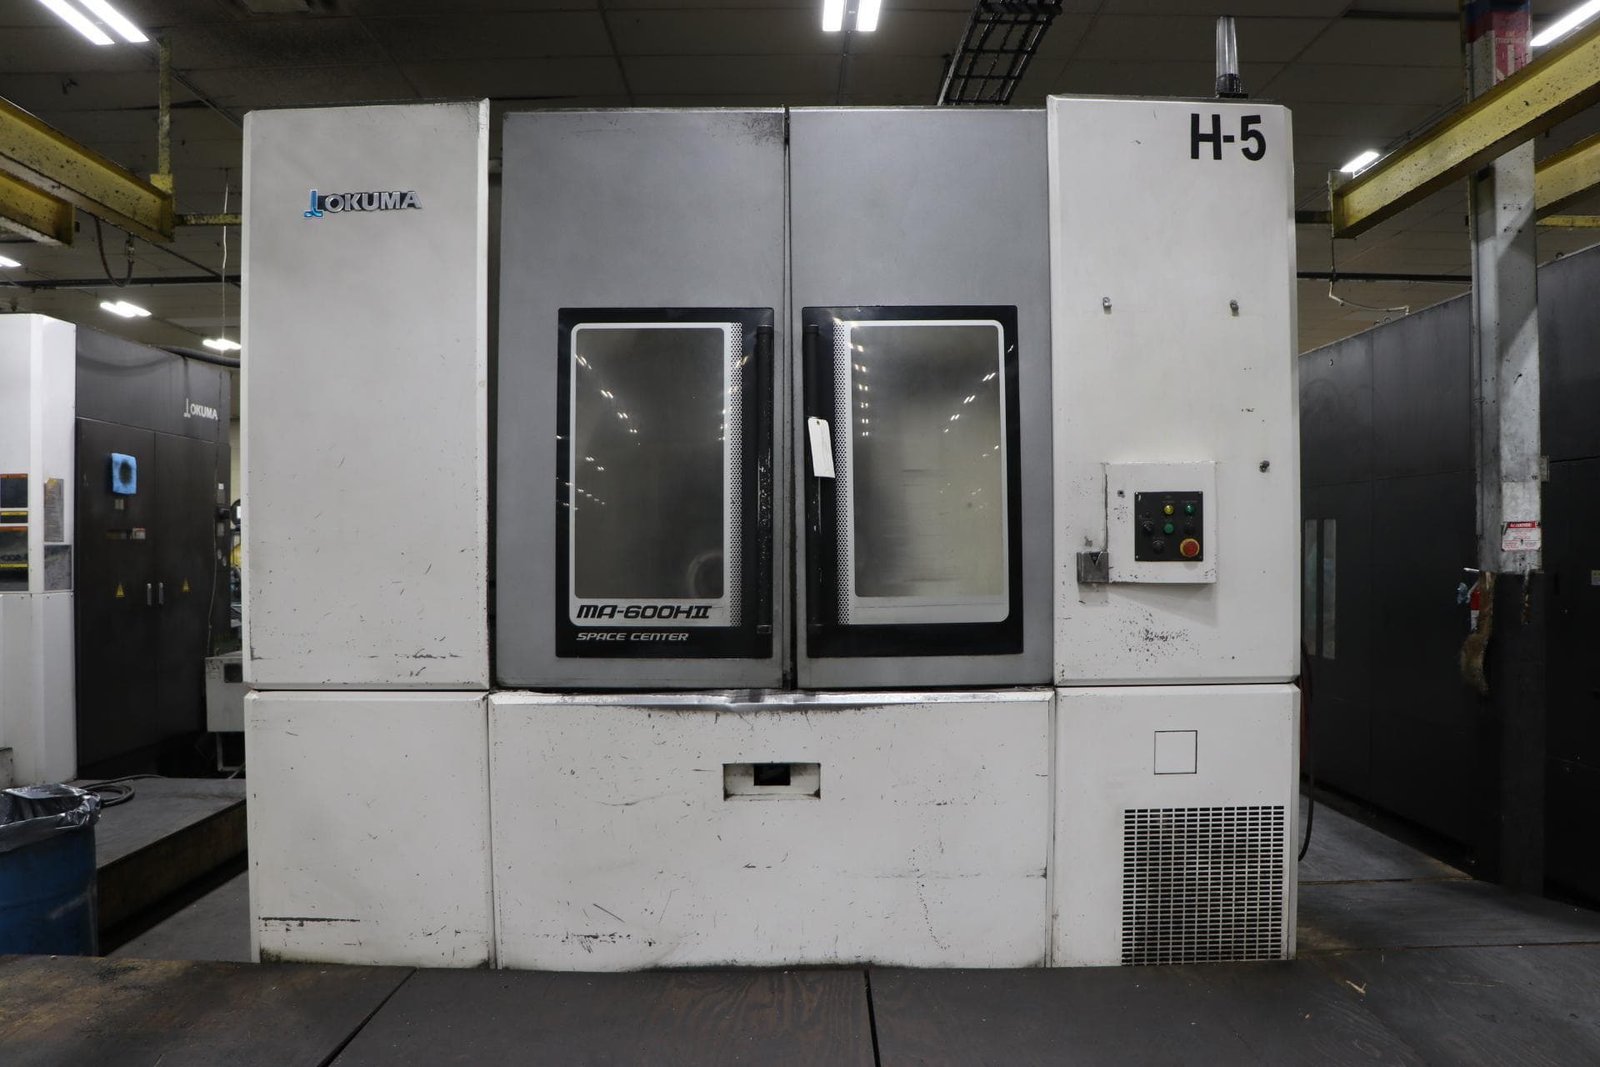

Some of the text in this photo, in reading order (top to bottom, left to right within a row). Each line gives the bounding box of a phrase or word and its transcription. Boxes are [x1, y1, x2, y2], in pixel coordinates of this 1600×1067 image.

[1190, 113, 1266, 161] H-5
[324, 191, 422, 213] OKUMA
[190, 403, 218, 420] OKUMA
[576, 632, 689, 641] SPACE CENTER
